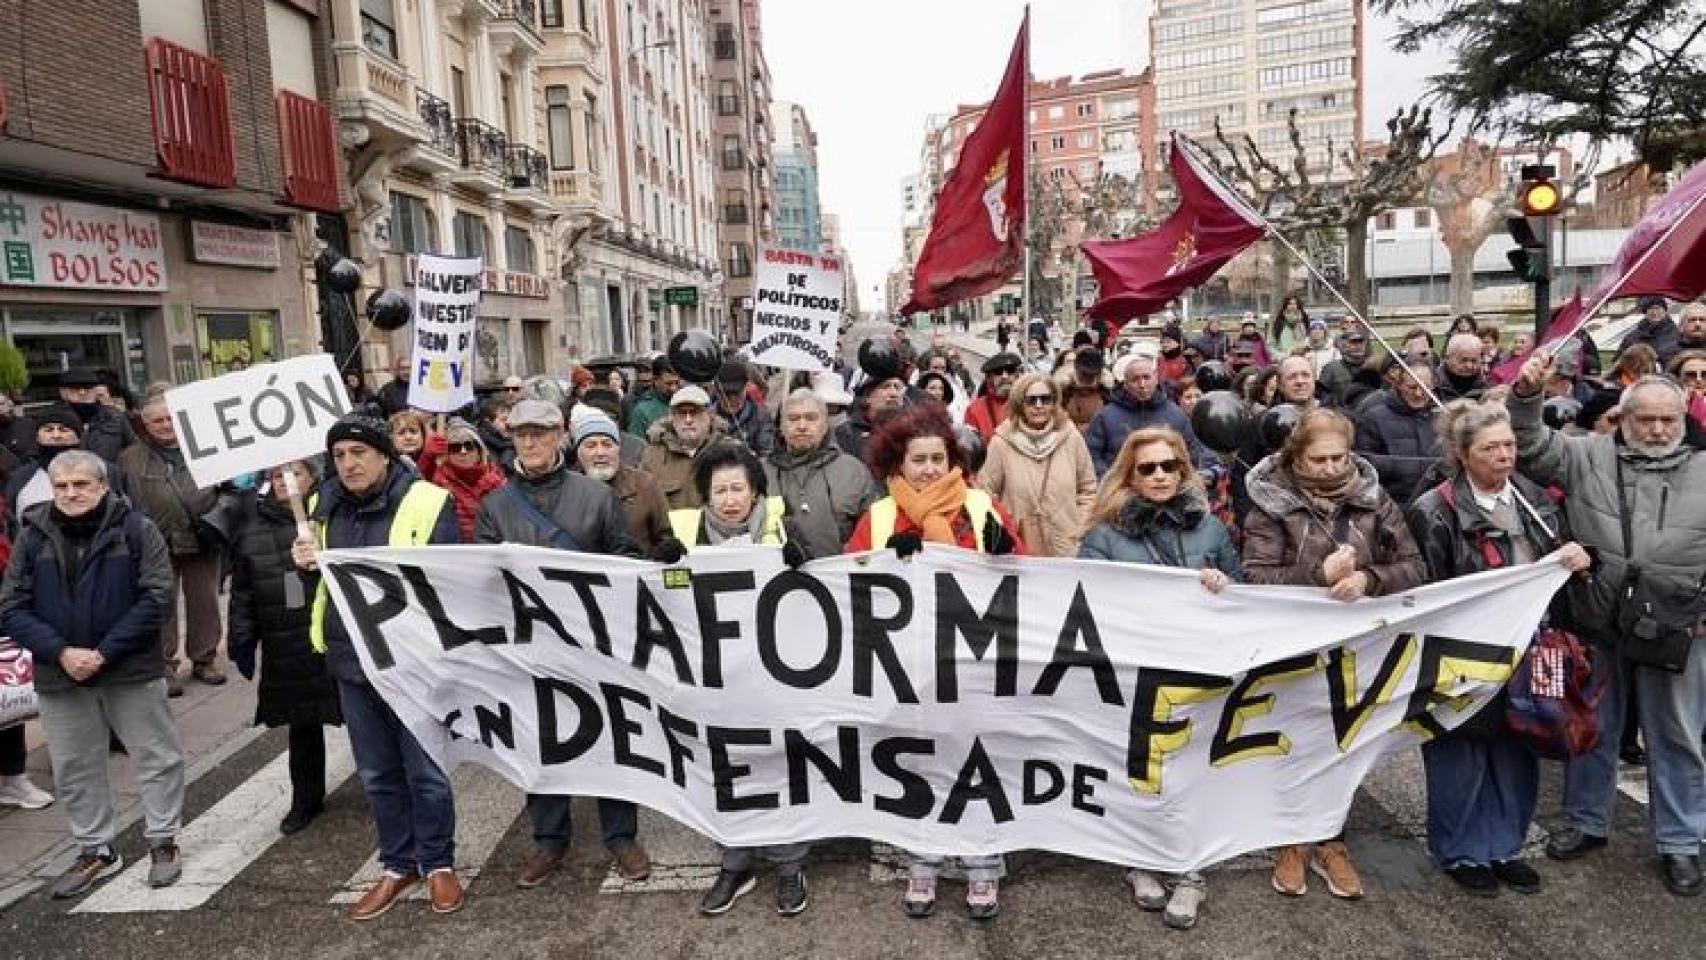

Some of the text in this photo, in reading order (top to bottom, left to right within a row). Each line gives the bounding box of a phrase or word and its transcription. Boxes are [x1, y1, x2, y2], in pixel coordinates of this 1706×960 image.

[40, 201, 119, 254] Shang
[48, 249, 160, 287] BOLSOS
[764, 249, 813, 267] BASTA
[787, 272, 807, 289] DE
[420, 301, 475, 324] NUESTR
[758, 286, 839, 312] POLÍTICOS
[756, 311, 830, 335] NECIOS Y
[176, 373, 346, 460] LEÓN
[328, 563, 1125, 706] PLATAFORMA
[532, 676, 1015, 825] DEFENSA
[1023, 759, 1109, 817] DE
[1127, 632, 1524, 796] FEVE
